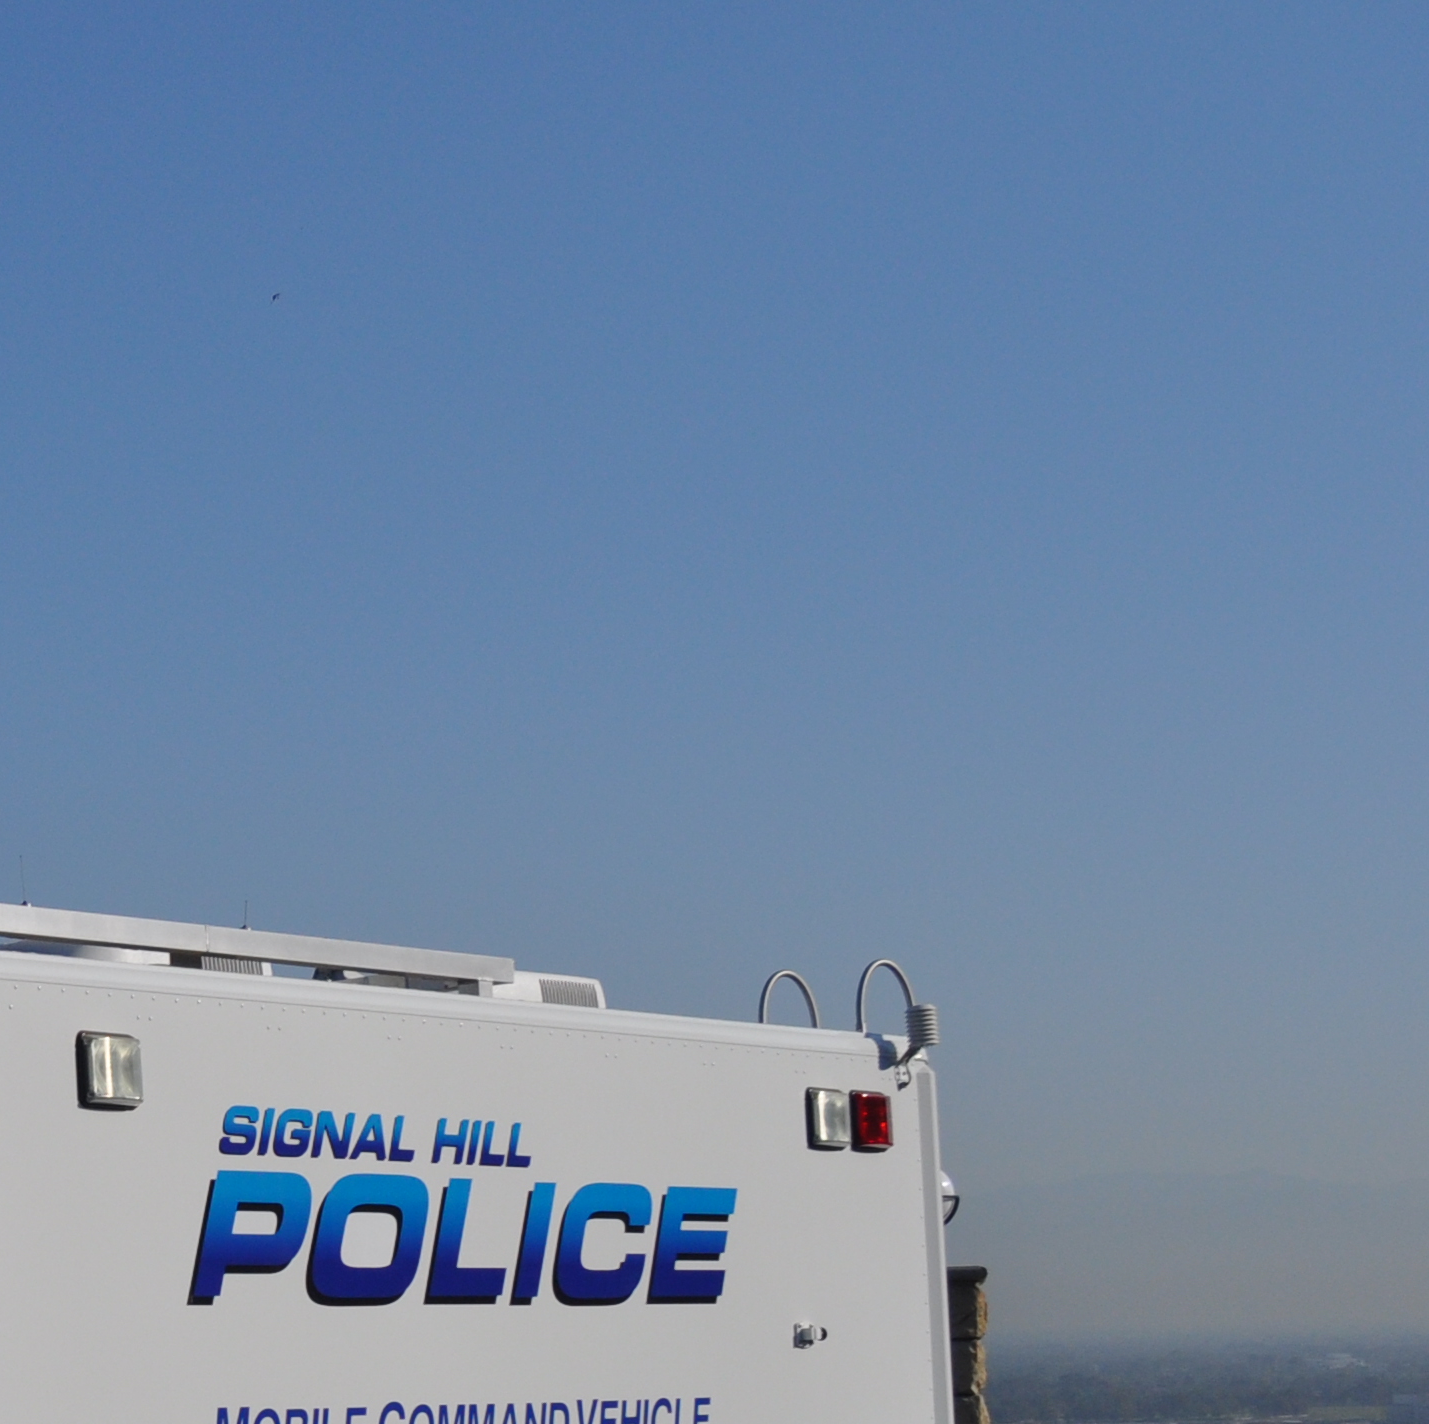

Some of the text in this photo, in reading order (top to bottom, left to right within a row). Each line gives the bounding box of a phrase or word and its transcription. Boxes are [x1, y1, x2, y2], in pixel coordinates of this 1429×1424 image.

[218, 1104, 532, 1168] SIGNAL HILL
[187, 1169, 738, 1307] POLICE
